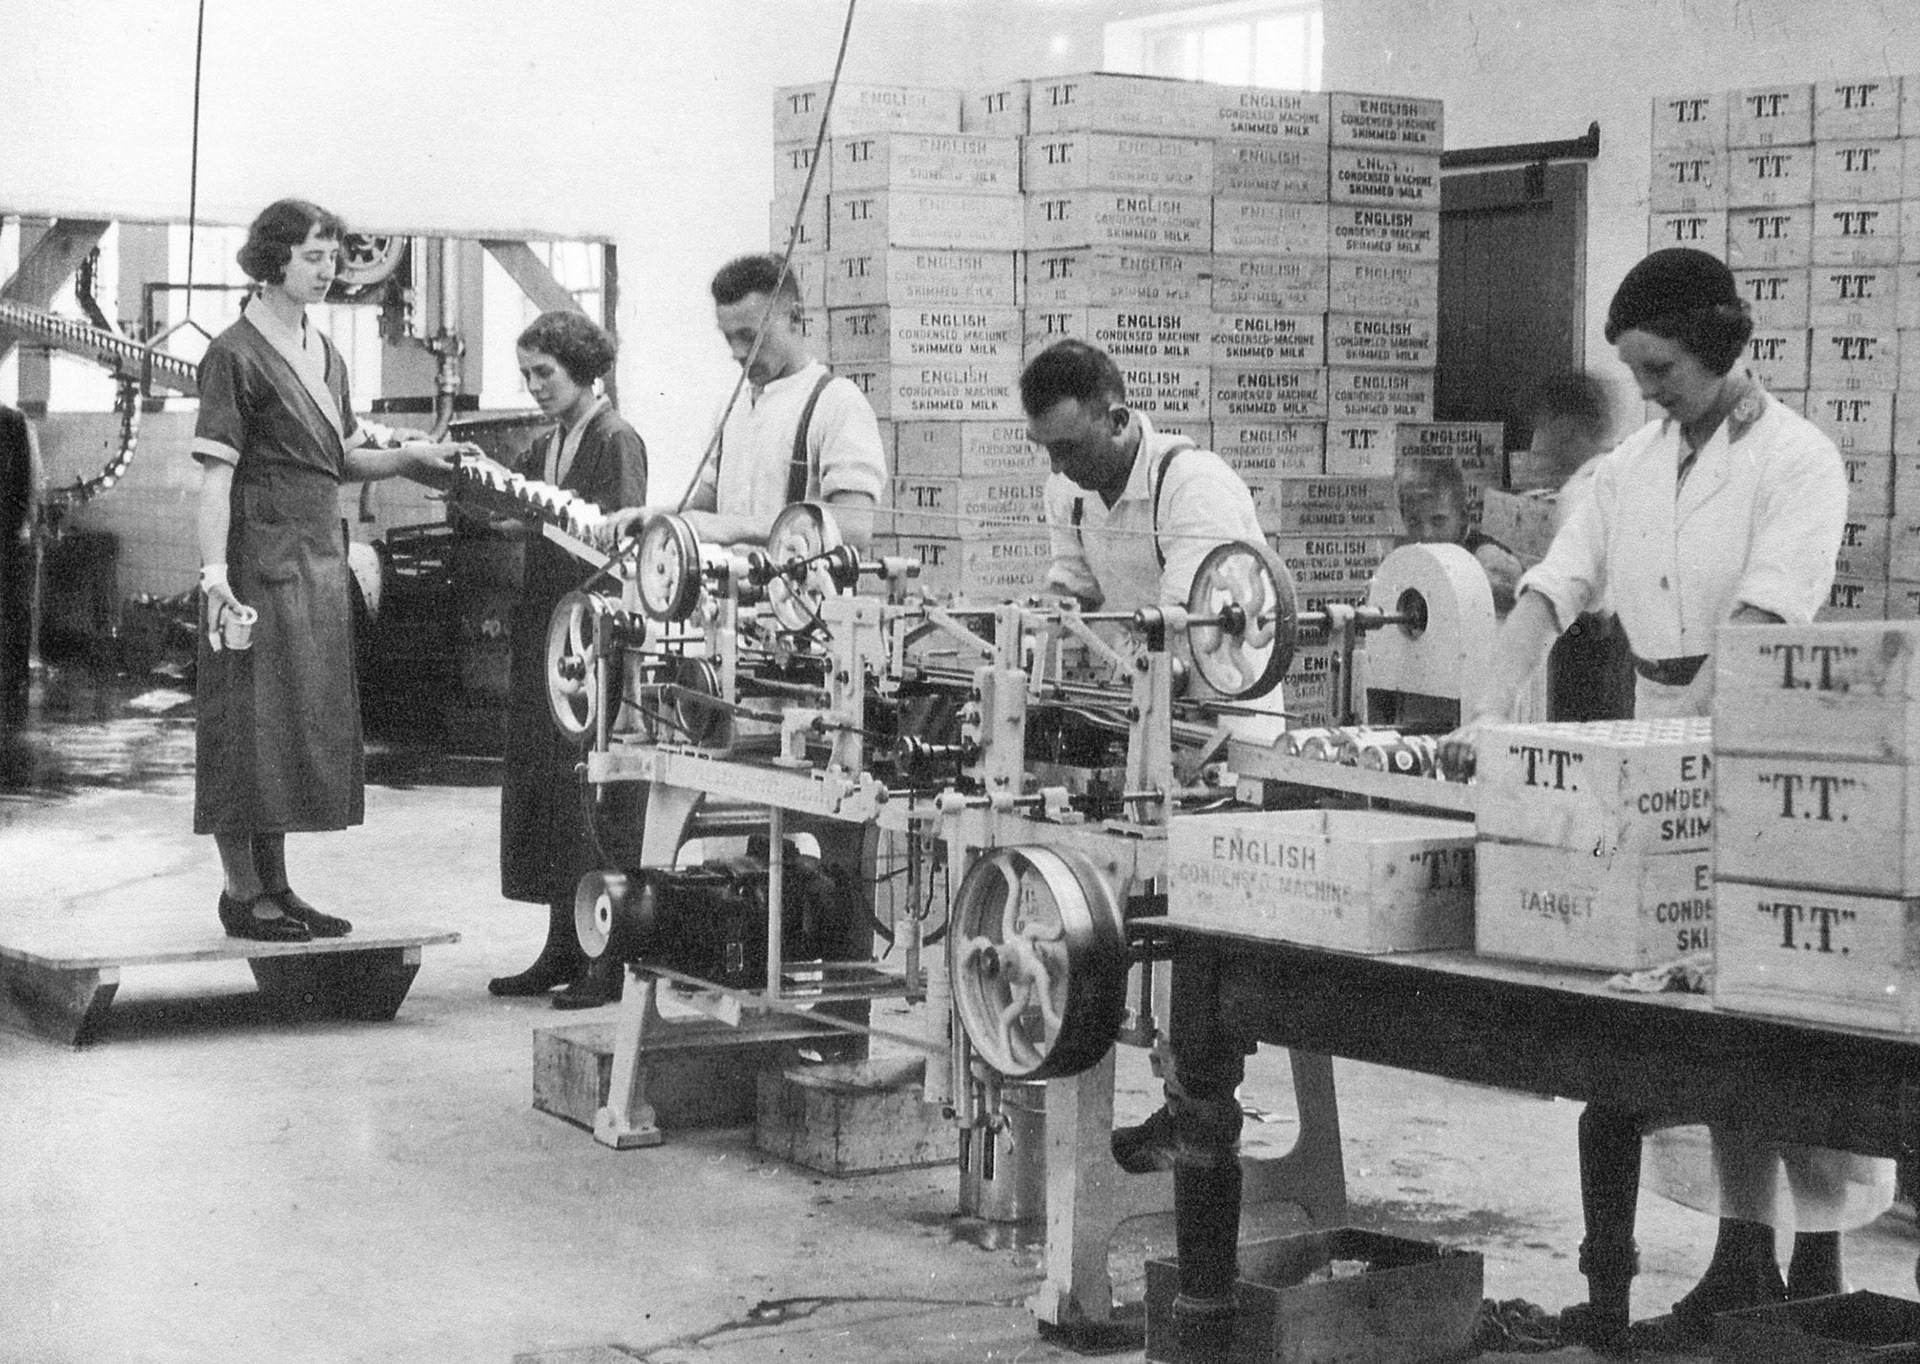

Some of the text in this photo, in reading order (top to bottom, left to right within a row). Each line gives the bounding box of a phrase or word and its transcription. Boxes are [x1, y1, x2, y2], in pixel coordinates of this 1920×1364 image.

[1360, 101, 1418, 116] ENGLISH
[1231, 123, 1310, 136] SKIMMED MILK
[1352, 128, 1426, 143] SKIMMED MILK
[1349, 184, 1422, 198] SKIMMED MILK
[1117, 199, 1181, 213] ENGLISH
[1354, 211, 1413, 226] ENGLISH
[921, 314, 986, 327] ENGLISH
[1117, 314, 1181, 329] ENGLISH
[1234, 319, 1296, 332] ENGLISH
[1354, 322, 1411, 335] ENGLISH
[1096, 331, 1200, 343] CONDENSED MACHINE
[911, 344, 997, 355] SKIMMED MILK
[1108, 344, 1190, 356] SKIMMED MILK
[1226, 347, 1305, 358] SKIMMED MILK
[1237, 374, 1299, 387] ENGLISH
[1354, 376, 1409, 389] ENGLISH
[1157, 389, 1200, 399] MACHINE
[1217, 390, 1273, 400] CONDENSED
[912, 400, 998, 411] SKIMMED MILK
[1164, 402, 1189, 412] MILK
[1229, 404, 1308, 414] SKIMMED MILK
[1240, 430, 1297, 443] ENGLISH
[1420, 430, 1478, 443] ENGLISH
[988, 485, 1043, 499] ENGLIS
[1308, 485, 1367, 498] ENGLISH
[1306, 542, 1366, 555] ENGLISH
[1212, 836, 1315, 871] ENGLISH
